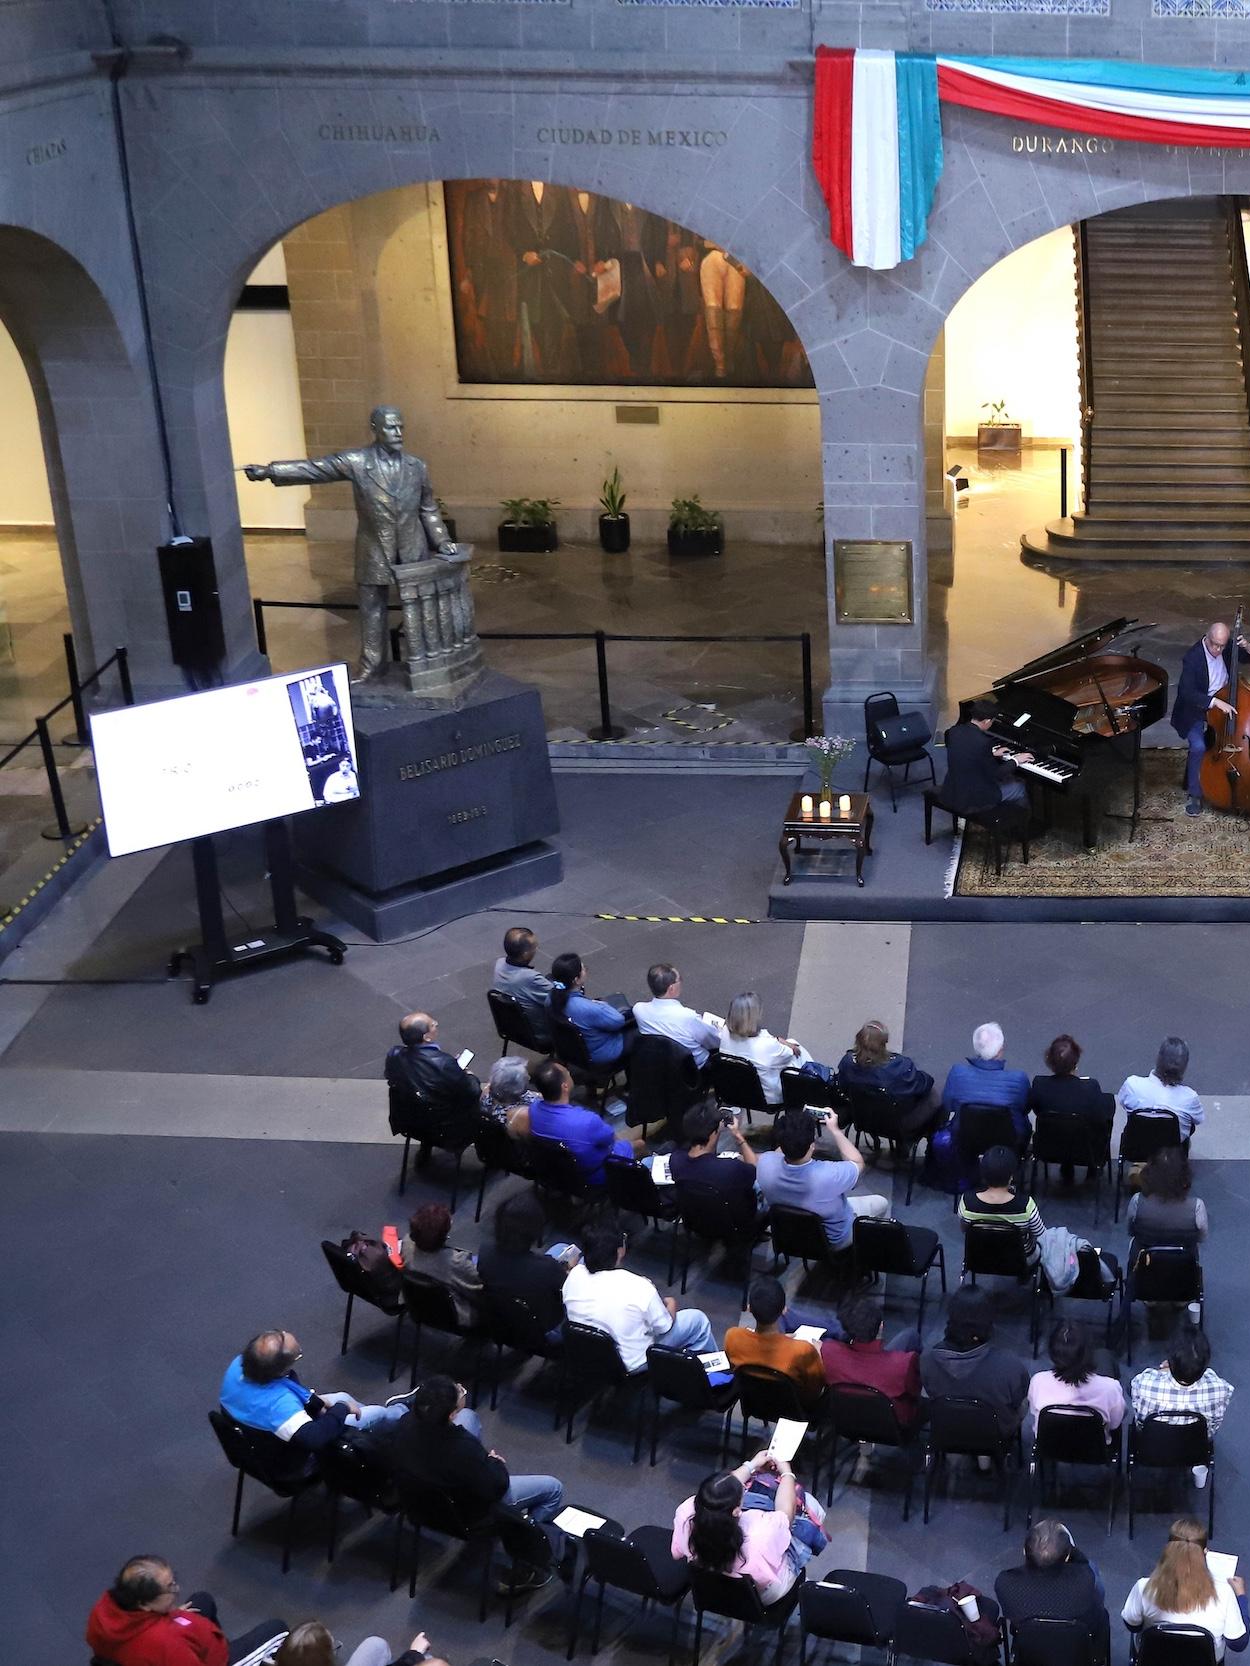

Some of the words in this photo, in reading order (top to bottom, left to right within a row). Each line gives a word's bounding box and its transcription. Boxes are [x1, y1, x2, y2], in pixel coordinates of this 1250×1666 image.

[319, 125, 440, 141] CHIHUAHUA
[537, 128, 612, 145] CIUDAD
[618, 130, 641, 145] DE
[648, 131, 728, 147] MEXICO
[1012, 135, 1114, 153] DURANGO
[399, 752, 458, 781] BELISARIO
